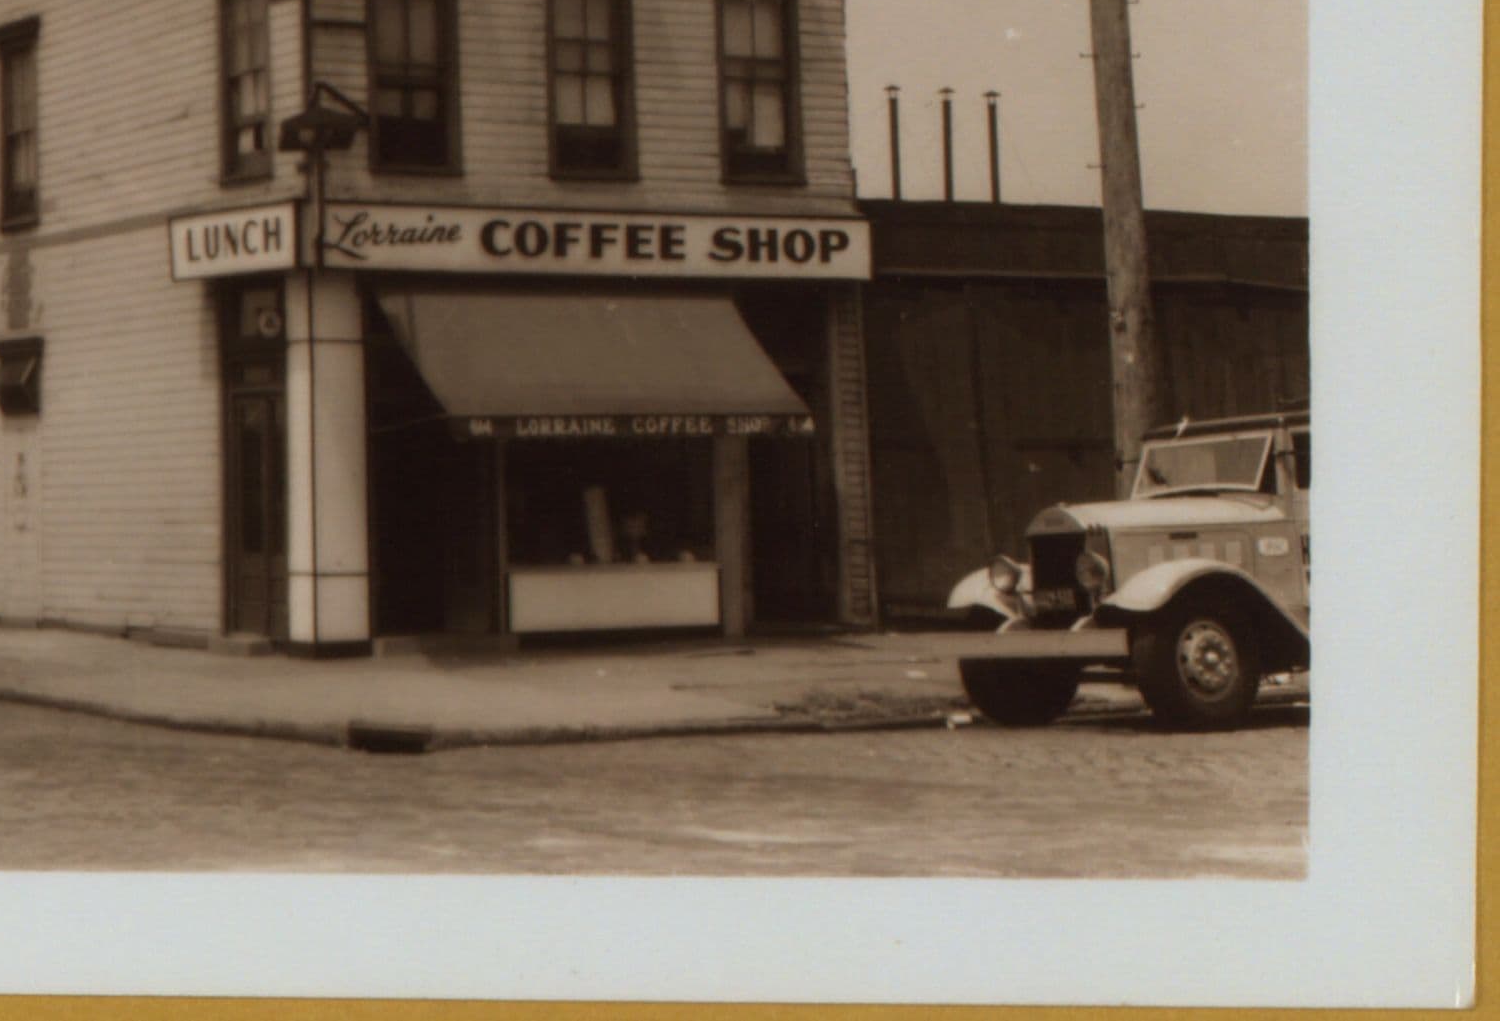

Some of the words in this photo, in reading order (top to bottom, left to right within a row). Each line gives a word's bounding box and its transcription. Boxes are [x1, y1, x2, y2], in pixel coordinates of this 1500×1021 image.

[186, 215, 282, 262] LUNCH
[321, 211, 463, 261] Lorraine
[480, 218, 687, 261] COFFEE
[707, 225, 850, 264] SHOP
[515, 418, 616, 438] LORRAINE
[631, 416, 713, 435] COFFEE
